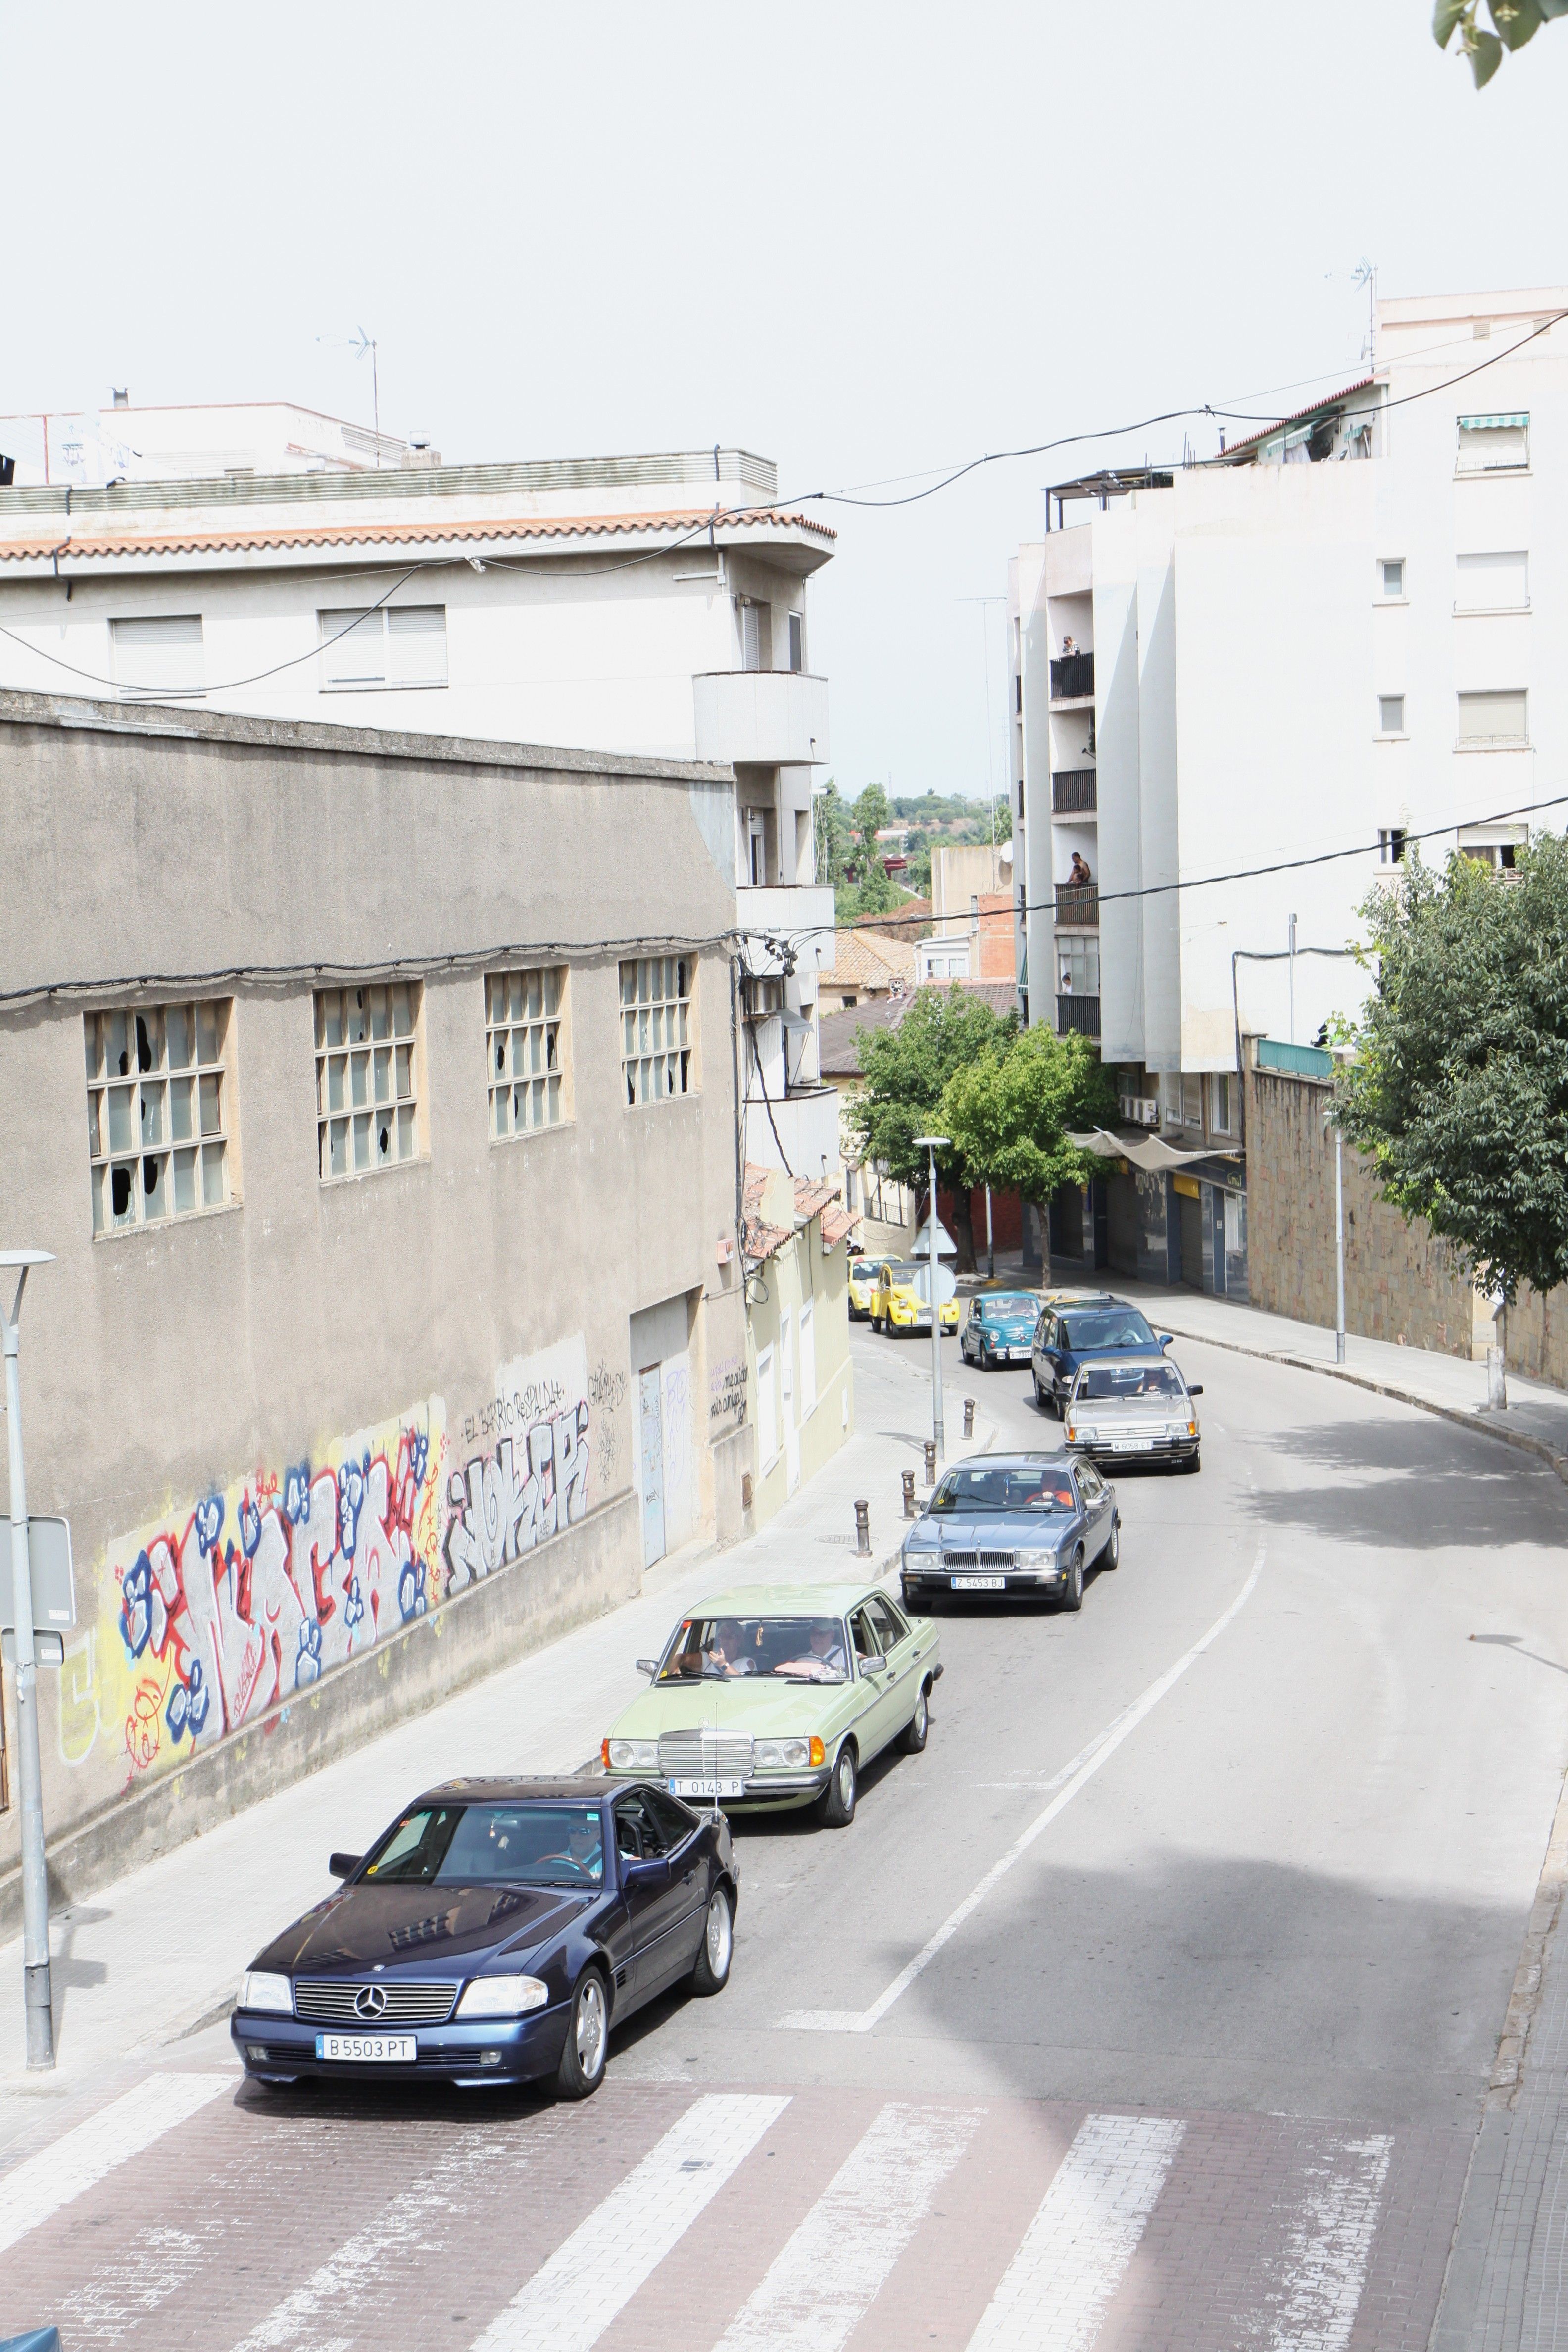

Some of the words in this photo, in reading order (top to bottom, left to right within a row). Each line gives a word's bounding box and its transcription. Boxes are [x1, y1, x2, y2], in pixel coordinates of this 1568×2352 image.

[465, 1414, 479, 1444] EL
[957, 1579, 963, 1587] Z
[966, 1578, 988, 1587] 5453
[992, 1579, 1003, 1587] BJ
[677, 1781, 683, 1793] T
[692, 1782, 722, 1793] 0143
[732, 1782, 738, 1793] P
[331, 2040, 338, 2055] B
[343, 2040, 383, 2056] 5503
[388, 2041, 407, 2056] PT
